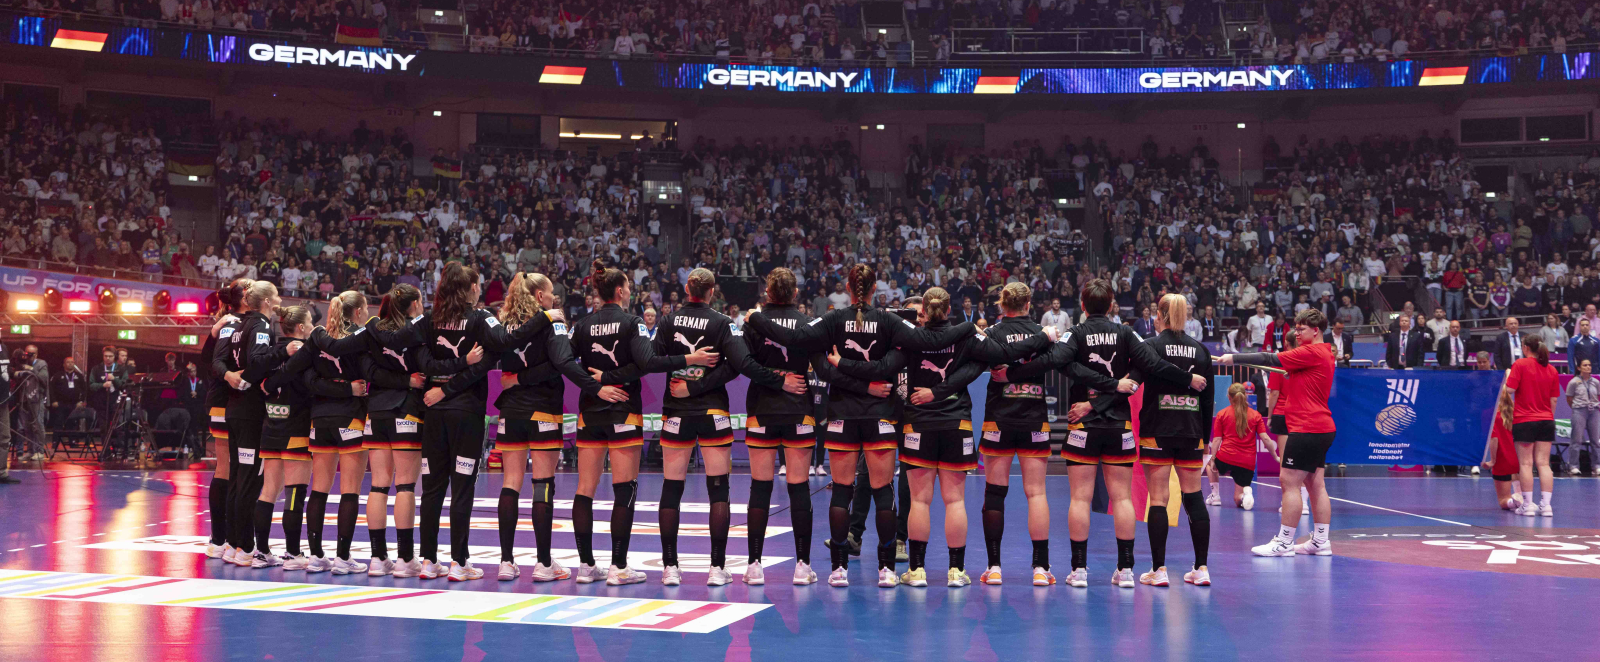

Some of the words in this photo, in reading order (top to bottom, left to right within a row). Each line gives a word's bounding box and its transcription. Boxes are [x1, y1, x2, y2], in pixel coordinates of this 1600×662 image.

[248, 43, 417, 71] GERMANY
[707, 68, 859, 88] GERMANY
[1139, 69, 1295, 89] GERMANY
[3, 273, 38, 287] UP
[42, 278, 93, 294] FOR
[590, 322, 621, 337] GERMANY
[673, 315, 710, 331] GERMANY
[1086, 332, 1118, 347] GERMANY
[1165, 344, 1197, 359] GERMANY
[266, 404, 290, 415] SCO
